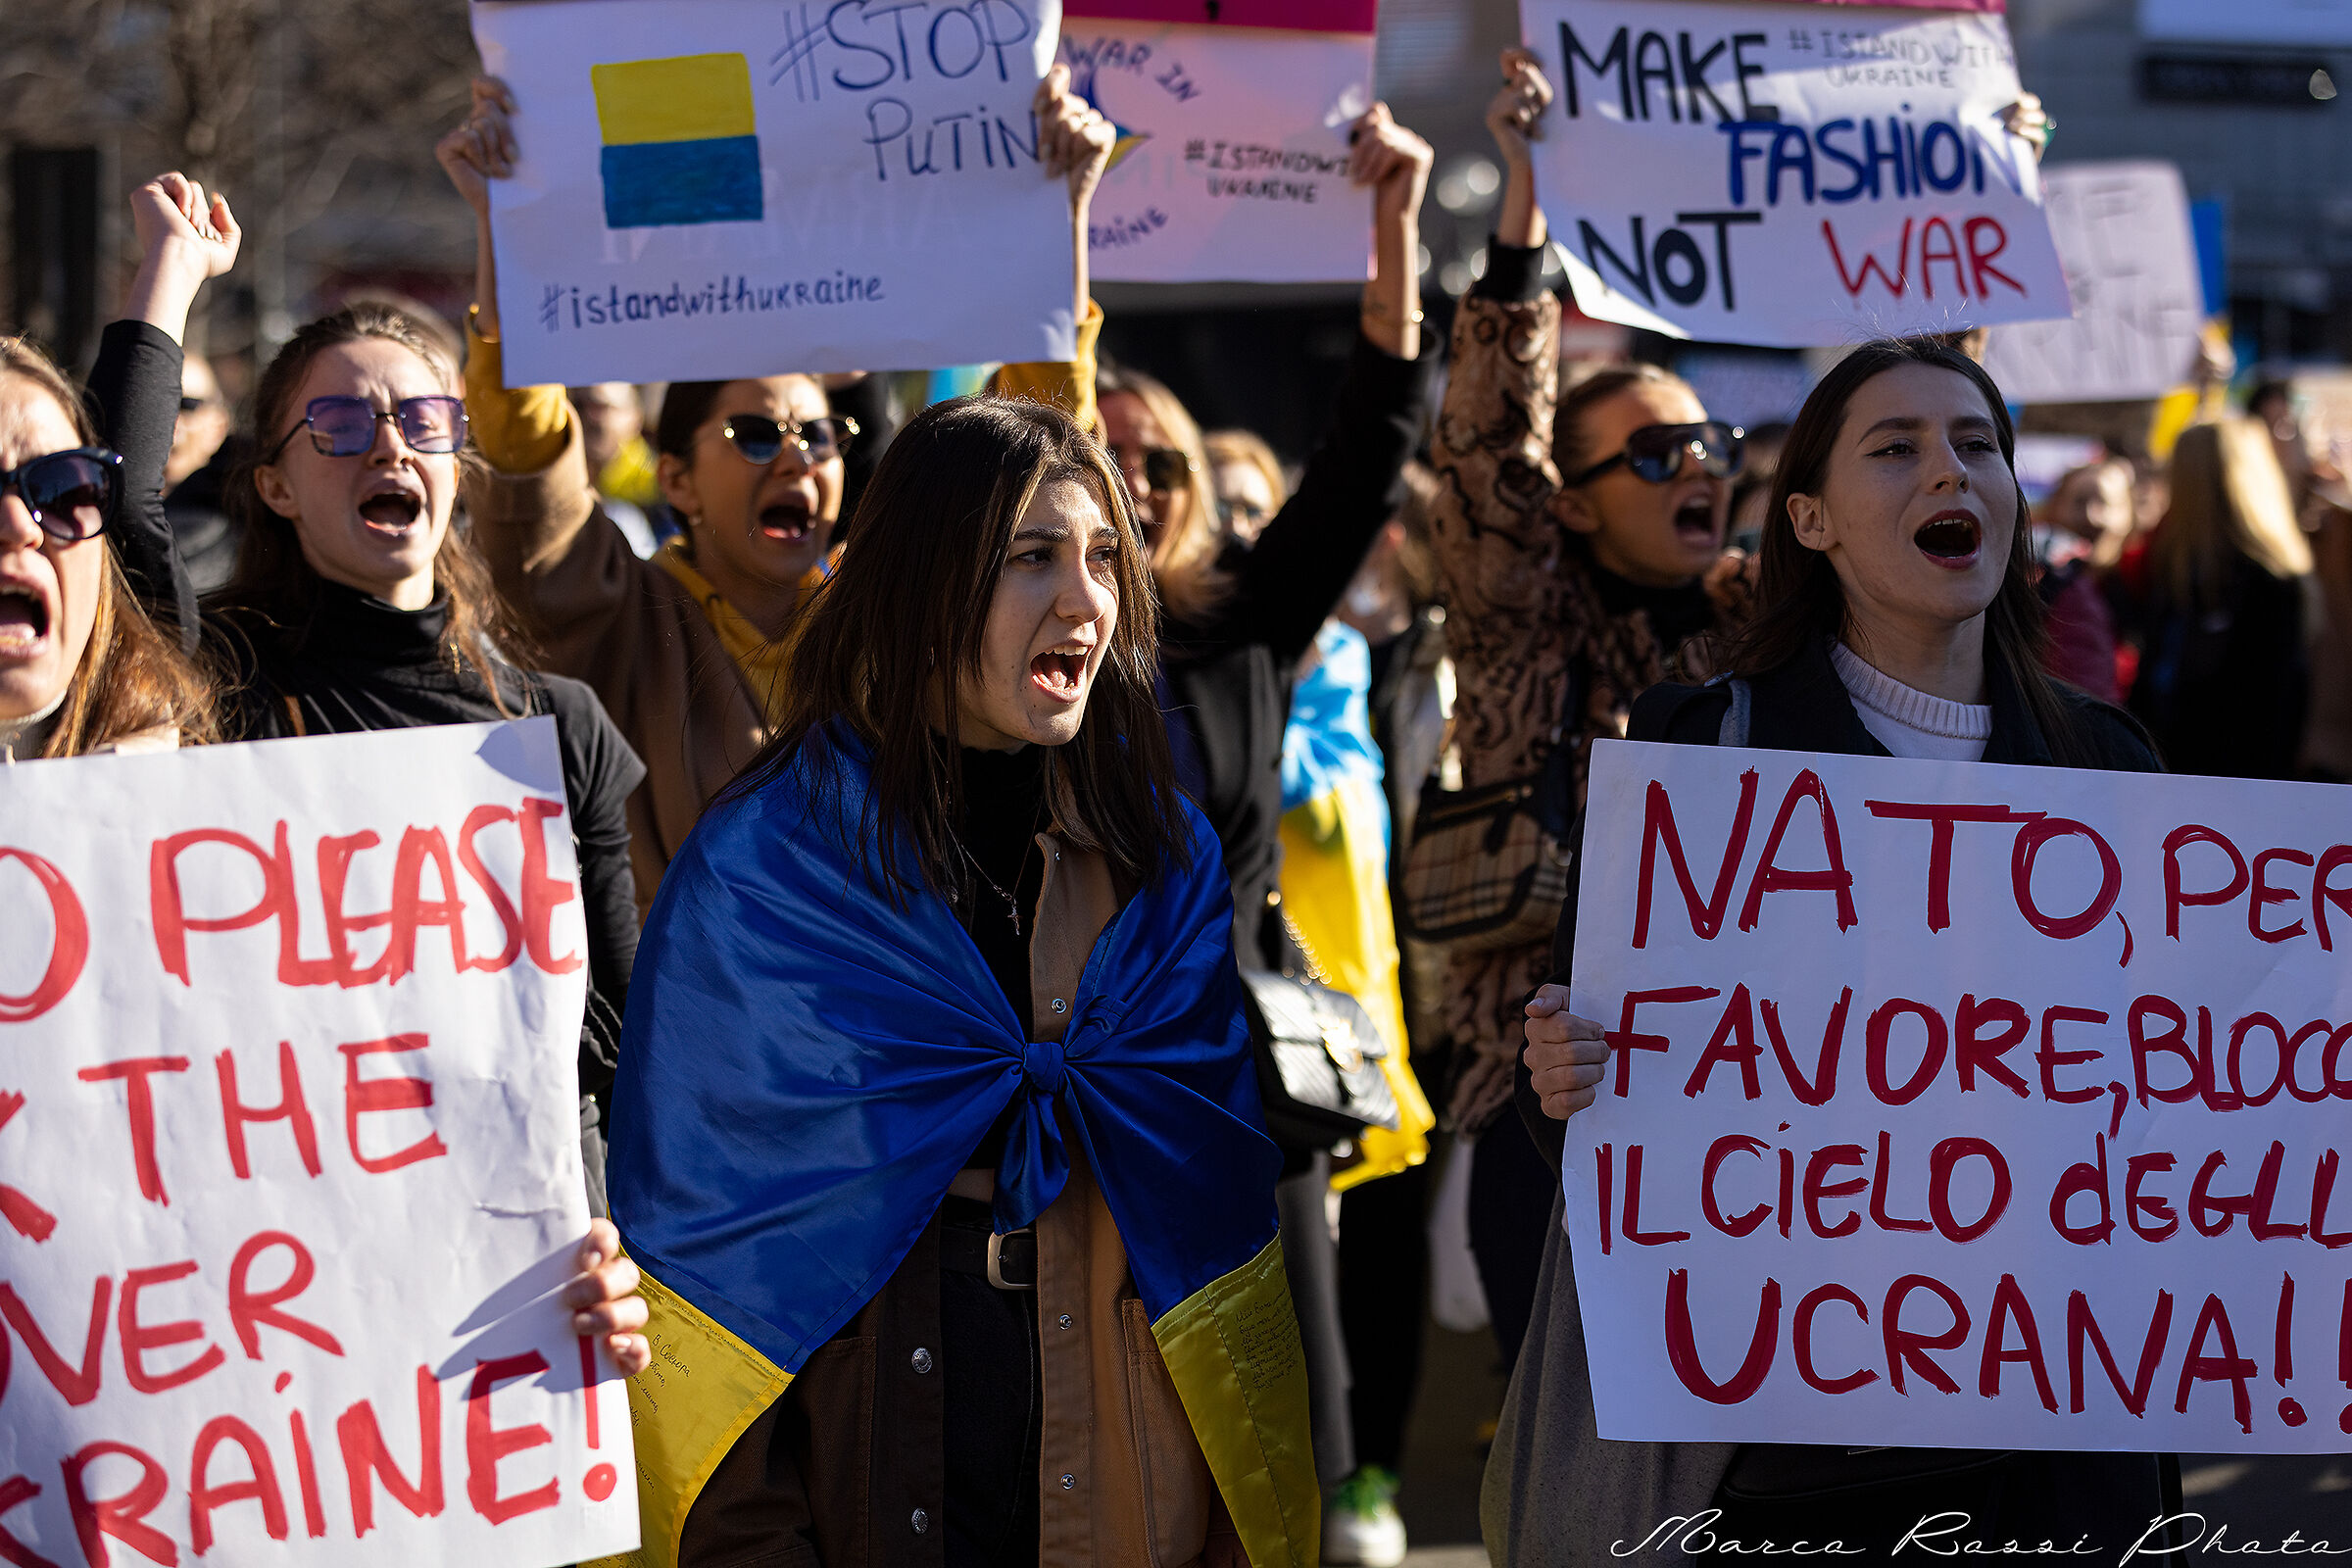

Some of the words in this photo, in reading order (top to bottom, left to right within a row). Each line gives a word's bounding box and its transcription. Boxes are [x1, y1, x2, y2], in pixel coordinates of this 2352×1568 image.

[769, 0, 1031, 101] #STOP
[1061, 35, 1153, 75] WAR
[1557, 21, 1780, 123] MAKE
[1576, 211, 1763, 312] NOT
[1821, 215, 2028, 301] WAR
[150, 797, 583, 989] PLEASE
[1632, 765, 2134, 968] NATO,
[77, 1032, 448, 1207] THE
[1596, 1142, 1690, 1255] IL
[0, 1230, 344, 1407] VER
